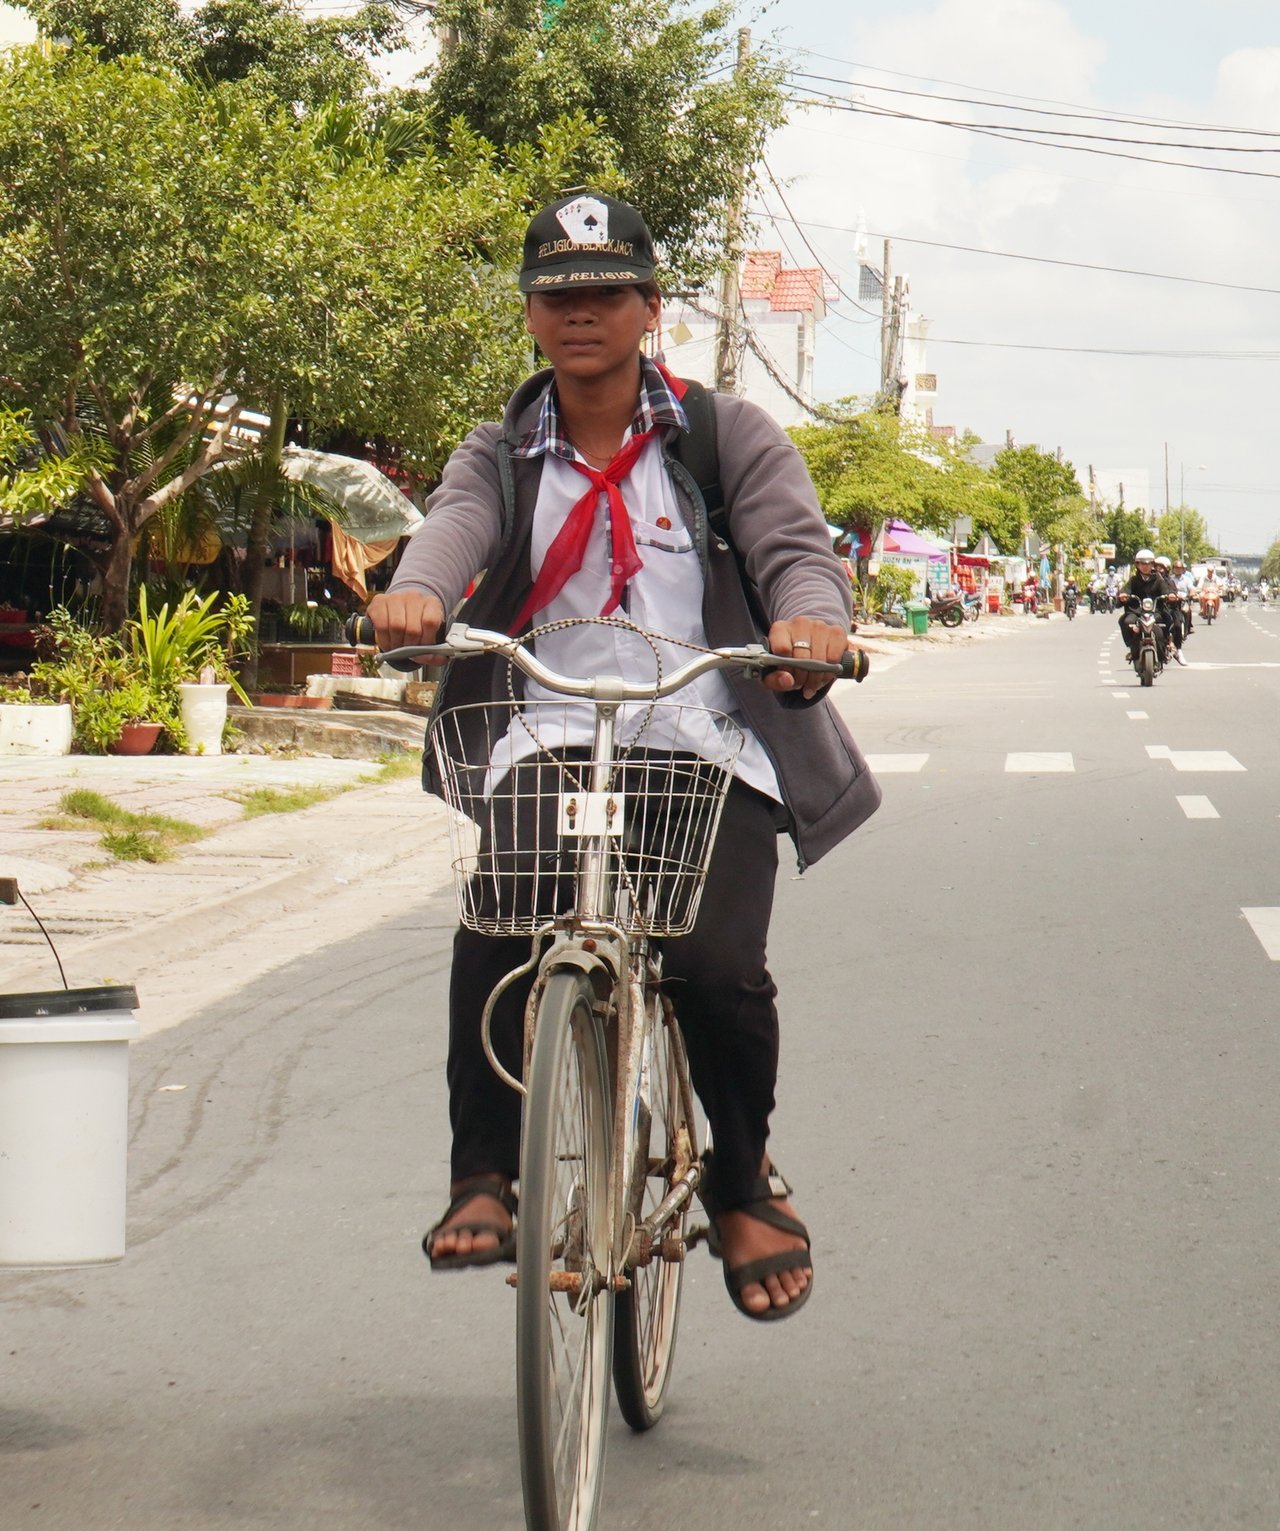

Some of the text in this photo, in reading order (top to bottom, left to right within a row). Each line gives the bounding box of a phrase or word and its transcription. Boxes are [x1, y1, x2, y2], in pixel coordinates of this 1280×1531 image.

[537, 238, 580, 258] RELIGION
[531, 271, 638, 285] TRUE RELIGION
